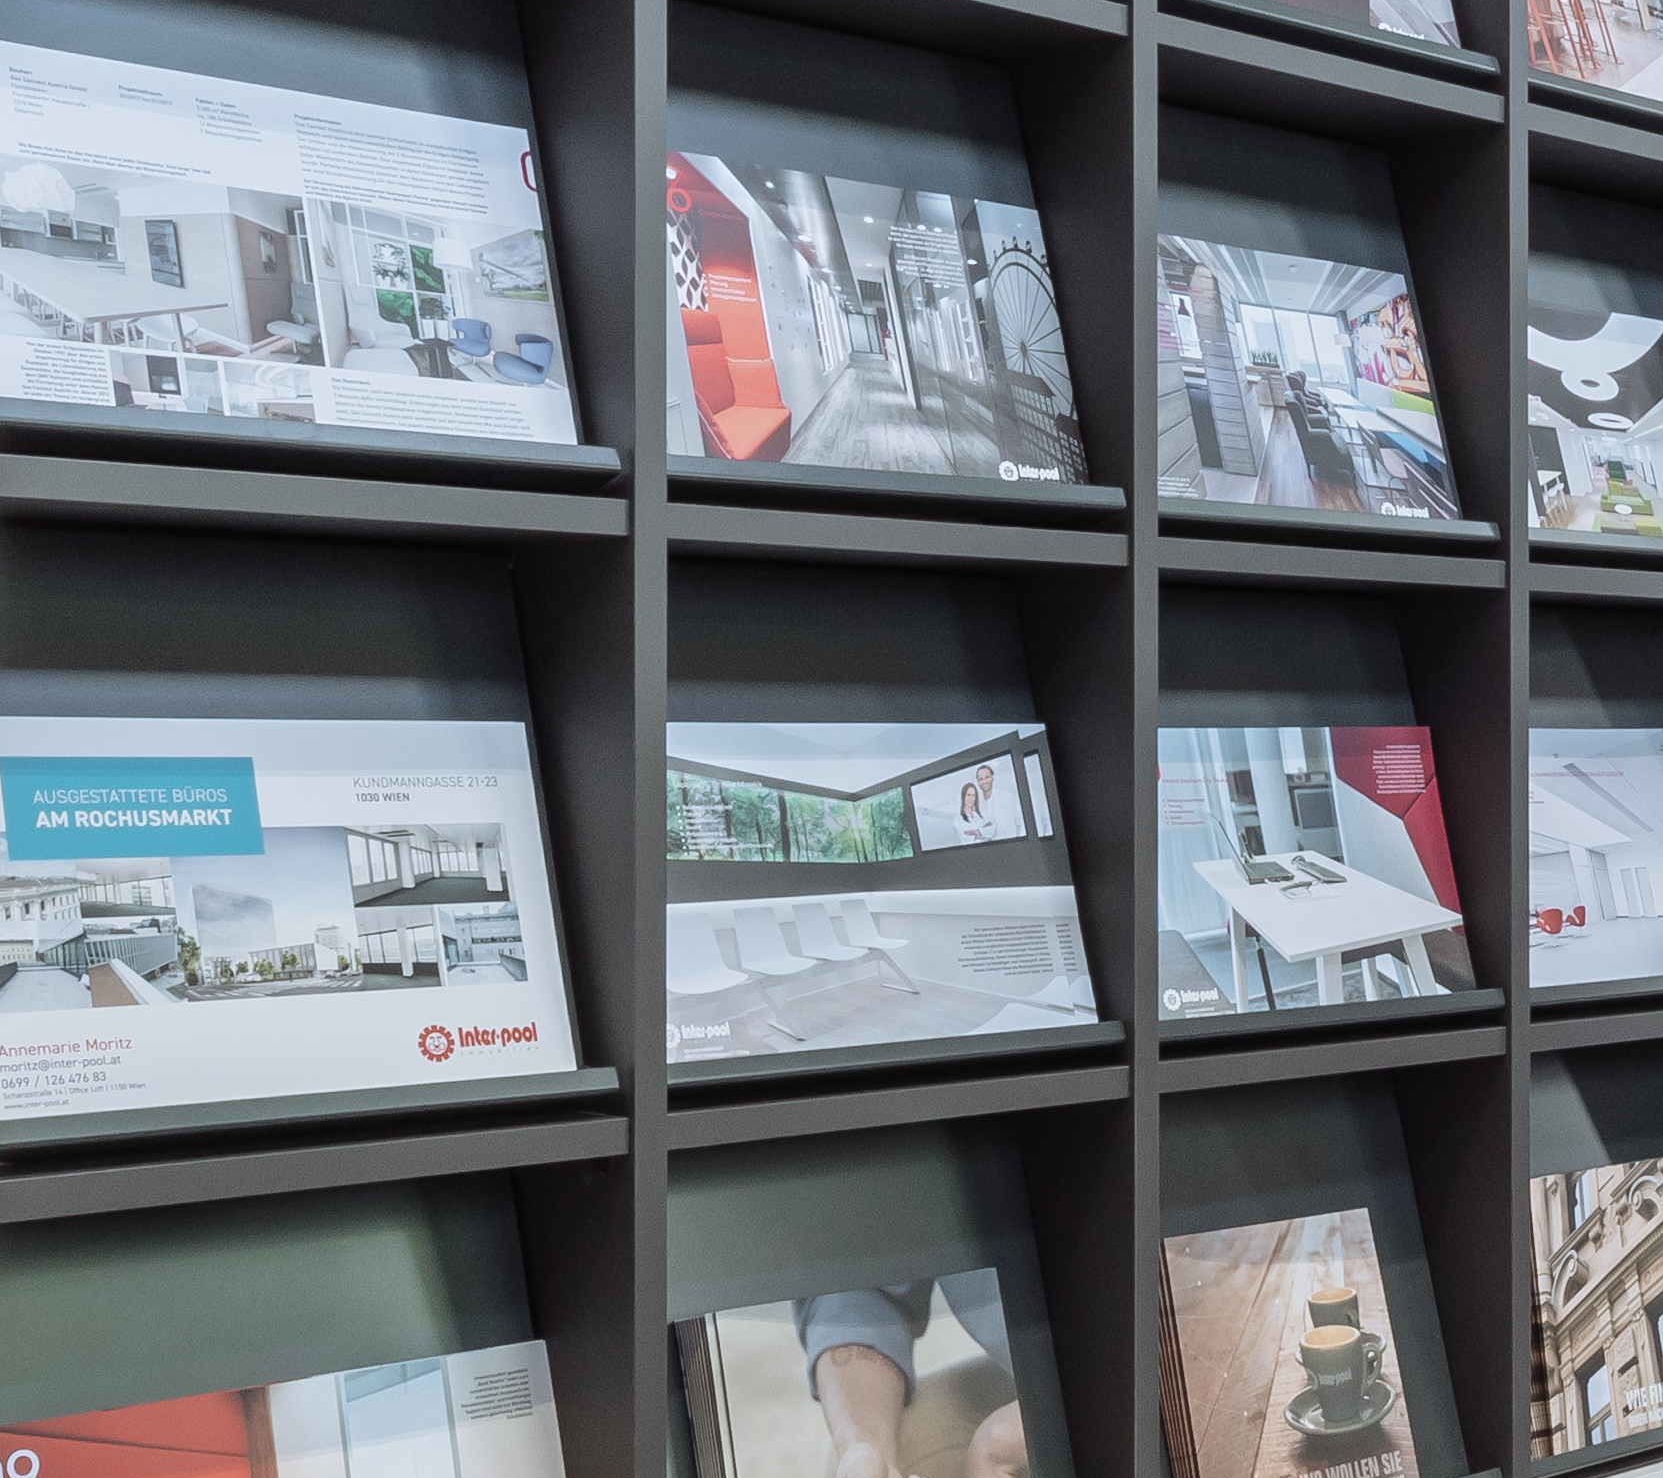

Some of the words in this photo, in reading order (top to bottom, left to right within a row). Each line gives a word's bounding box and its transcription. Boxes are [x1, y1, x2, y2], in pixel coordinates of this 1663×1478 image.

[353, 776, 464, 788] KUNDMANNGASSE
[467, 775, 498, 788] 21-23
[33, 788, 168, 805] AUSGESTATTETE
[173, 785, 228, 803] BÜROS
[355, 792, 380, 802] 1030
[382, 792, 410, 802] WIEN
[36, 810, 69, 828] AM
[74, 808, 233, 828] ROCHUSMARKT
[85, 1037, 133, 1052] Moritz
[0, 1055, 122, 1073] moritz@inter-pool.at
[1, 1077, 30, 1089] 0699
[45, 1074, 65, 1086] 126
[68, 1072, 90, 1083] 476
[93, 1071, 107, 1082] 83
[1626, 1387, 1647, 1411] WIE
[1381, 1450, 1403, 1475] SIE
